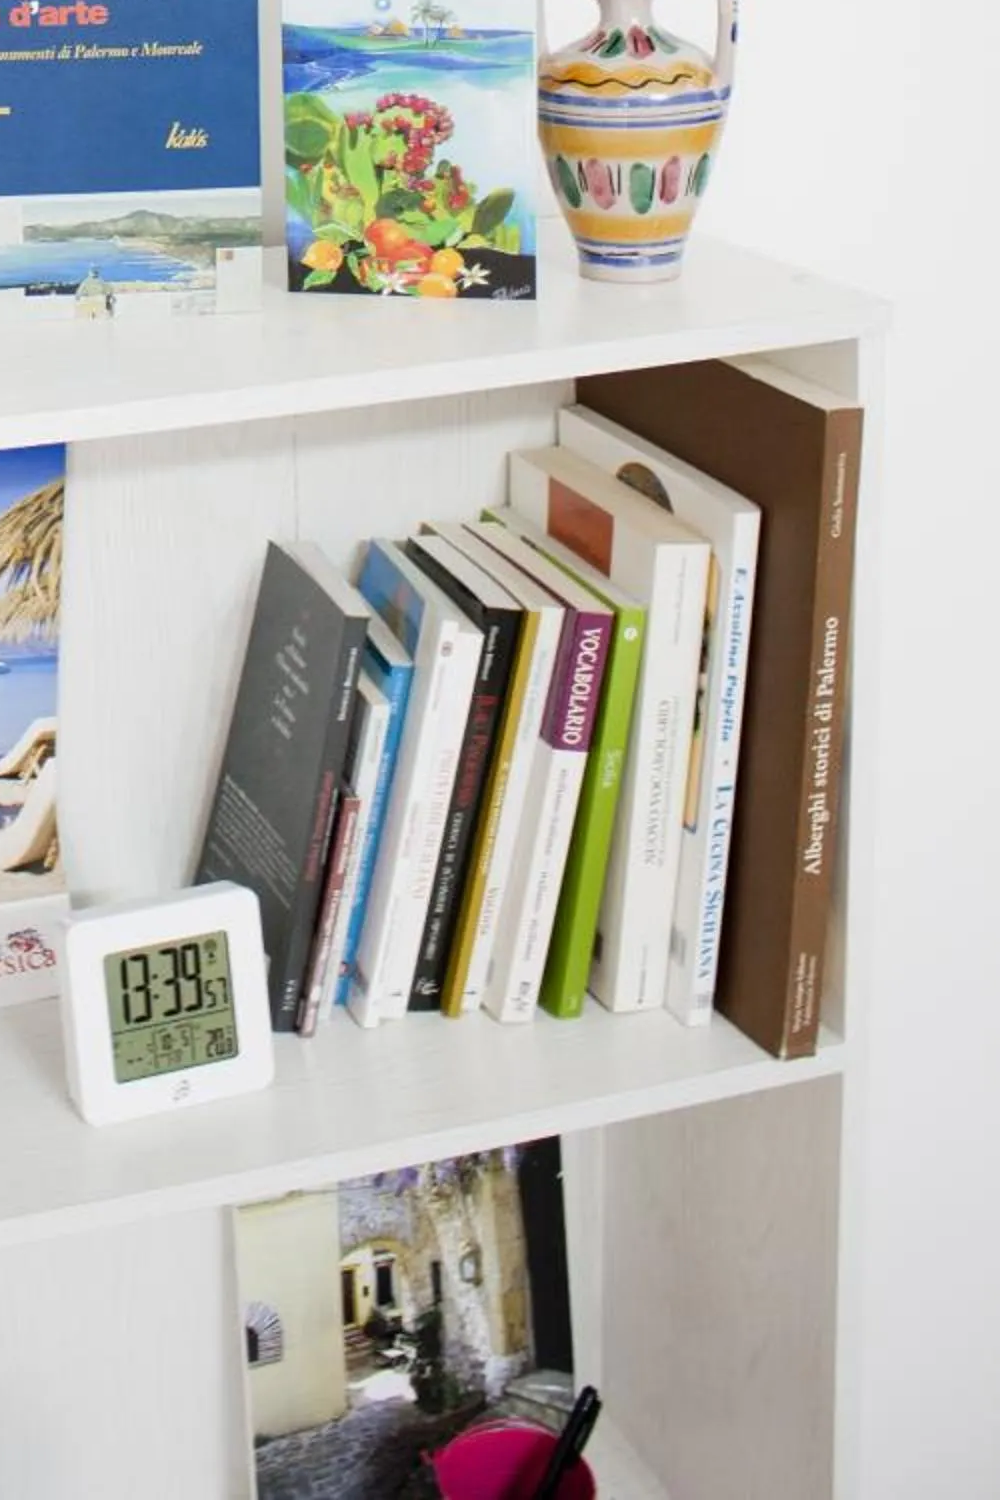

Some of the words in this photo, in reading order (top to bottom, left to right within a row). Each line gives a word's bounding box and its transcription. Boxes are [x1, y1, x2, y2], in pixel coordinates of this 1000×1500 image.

[9, 0, 109, 27] d'arte
[57, 44, 71, 60] di
[74, 43, 129, 60] Palermo
[561, 627, 604, 746] VOCABOLARIO
[816, 615, 840, 698] Palermo
[814, 702, 833, 722] di
[811, 727, 831, 788] storici
[804, 791, 830, 876] Alberghi
[119, 942, 204, 1025] 13:39
